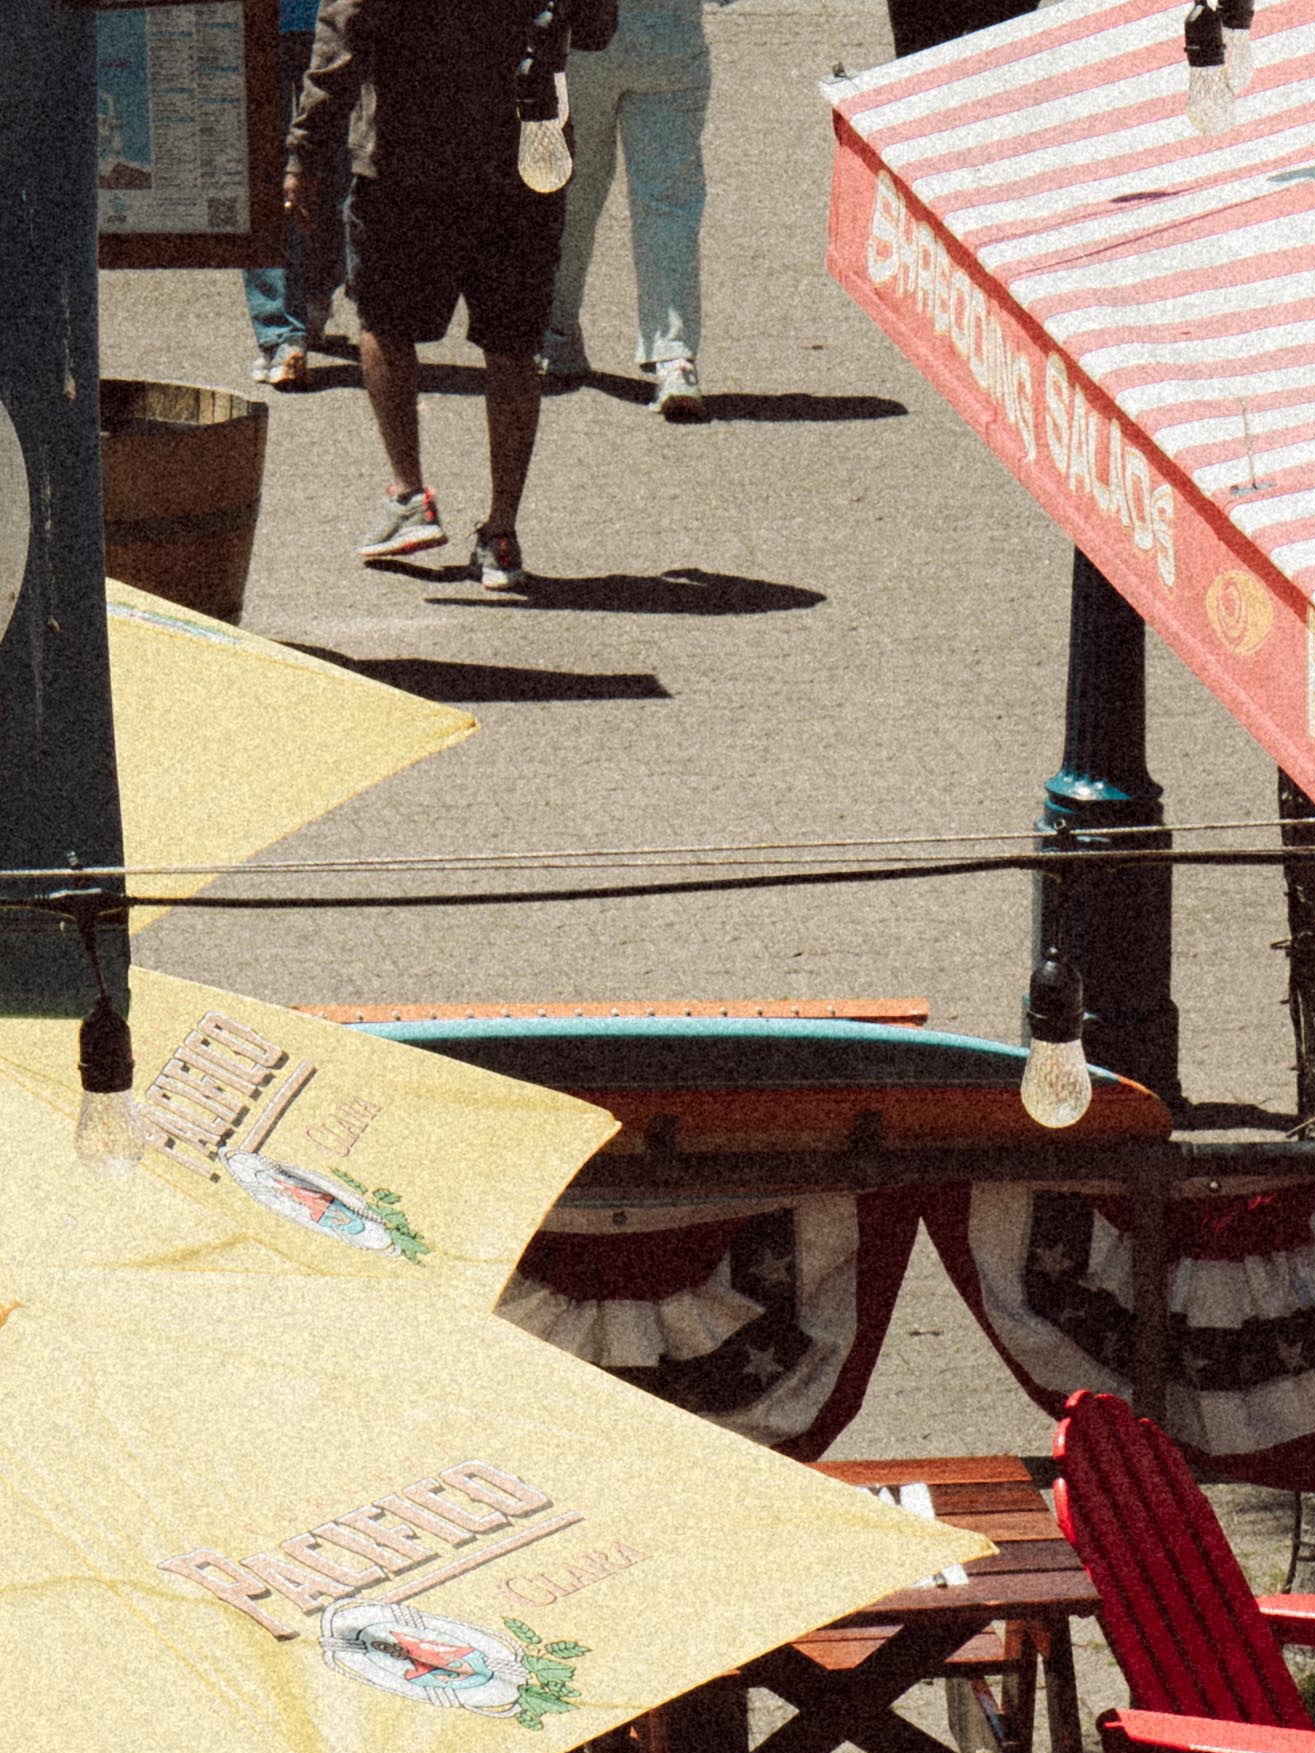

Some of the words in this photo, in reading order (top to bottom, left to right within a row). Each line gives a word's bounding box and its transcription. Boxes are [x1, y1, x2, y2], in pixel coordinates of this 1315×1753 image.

[867, 171, 1035, 465] SHREDDING
[1045, 352, 1176, 588] SALADS
[158, 1458, 554, 1643] PACIFICO
[498, 1540, 652, 1609] CLARA
